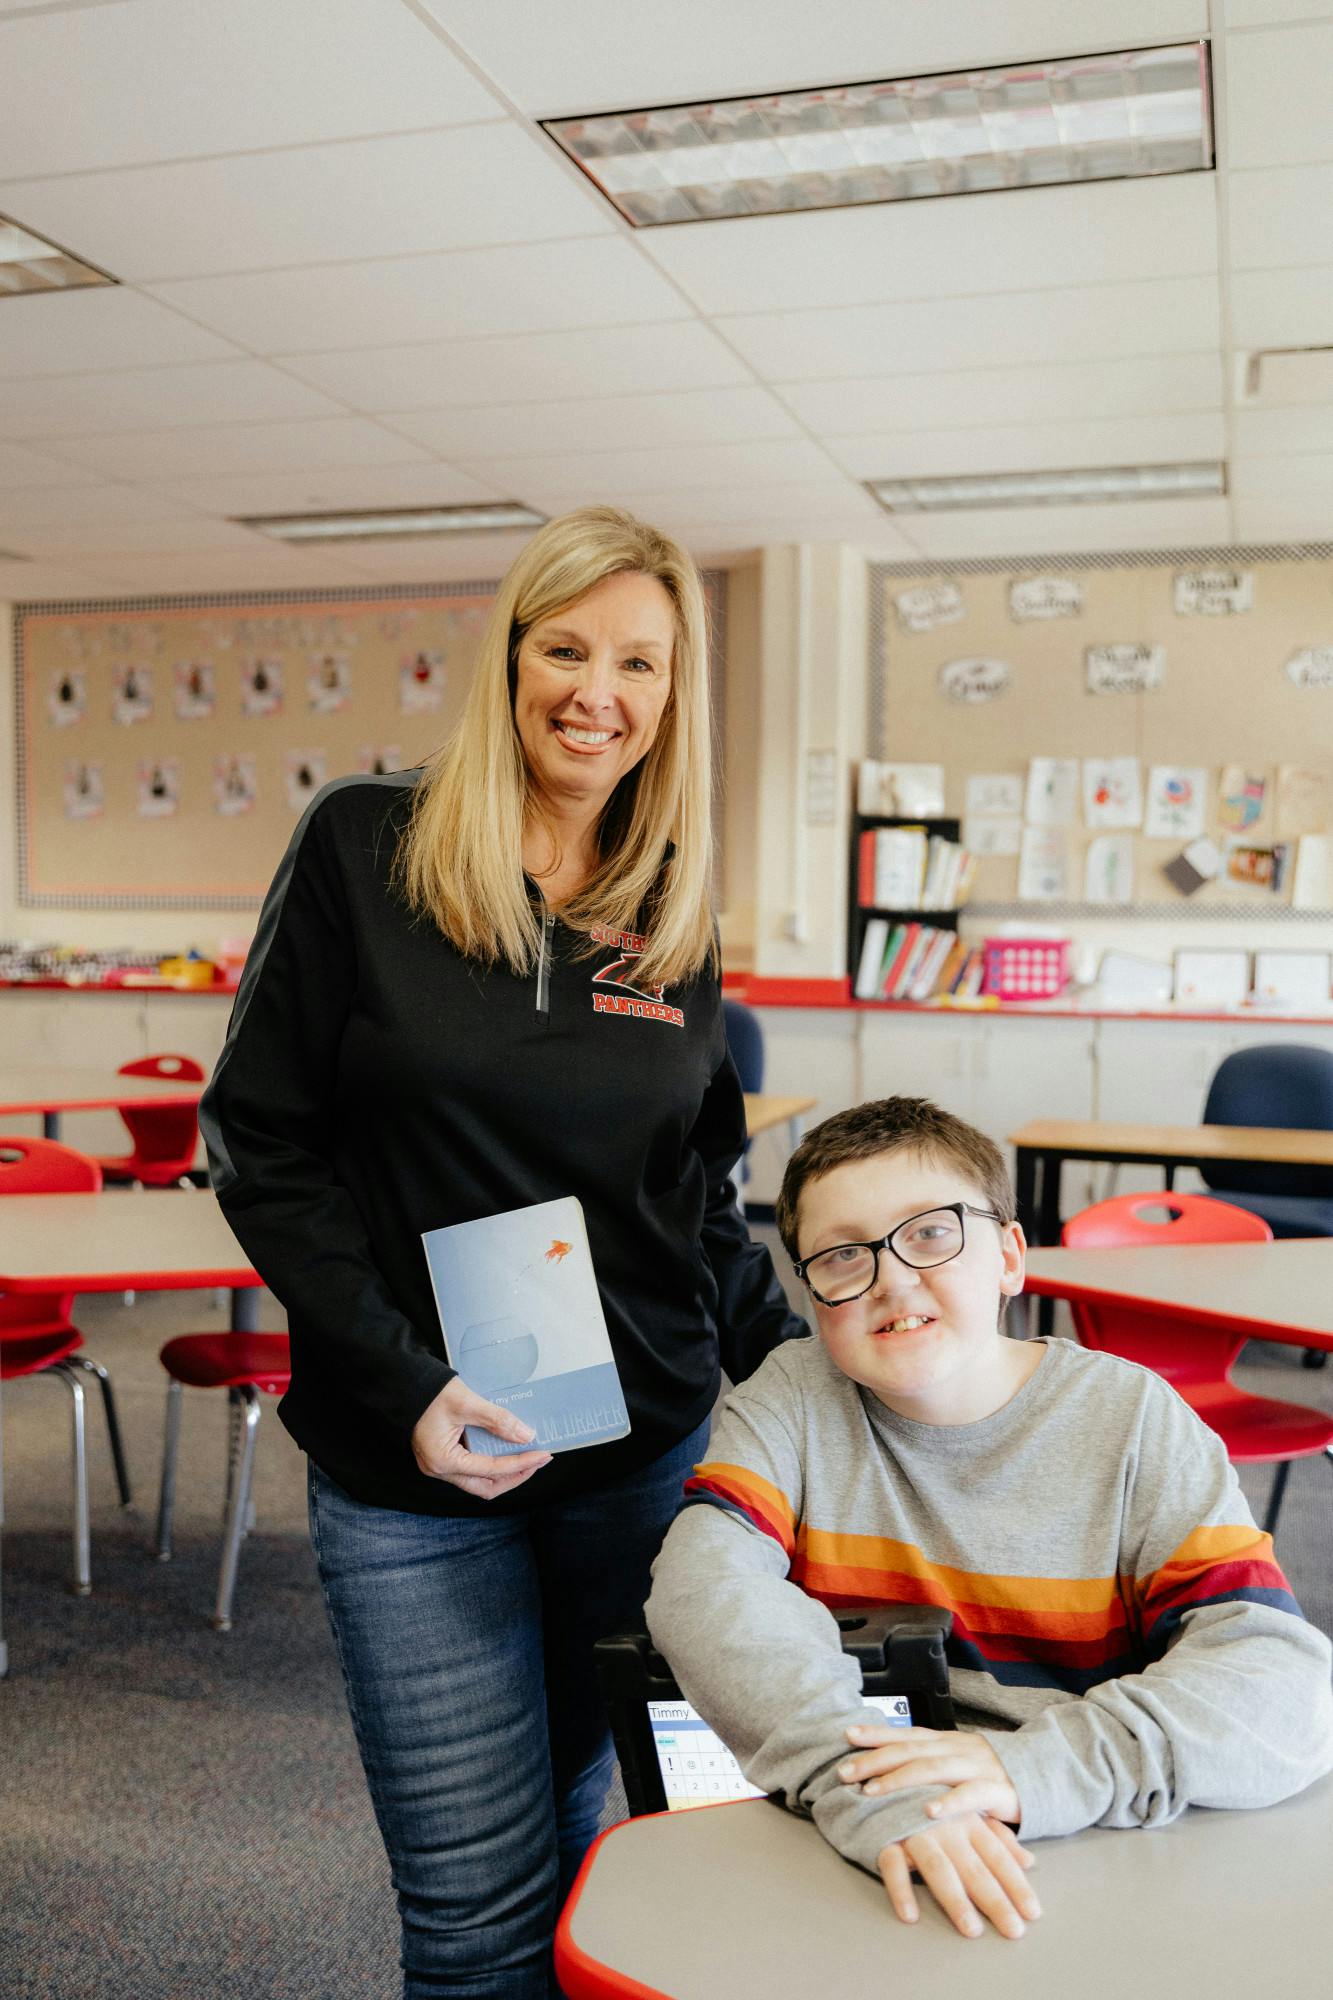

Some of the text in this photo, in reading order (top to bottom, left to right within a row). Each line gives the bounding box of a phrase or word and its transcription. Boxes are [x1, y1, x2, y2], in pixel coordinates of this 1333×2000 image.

[592, 993, 685, 1028] PANTHERS
[495, 1396, 511, 1408] my
[511, 1389, 533, 1402] mind
[649, 1707, 689, 1720] Timmy
